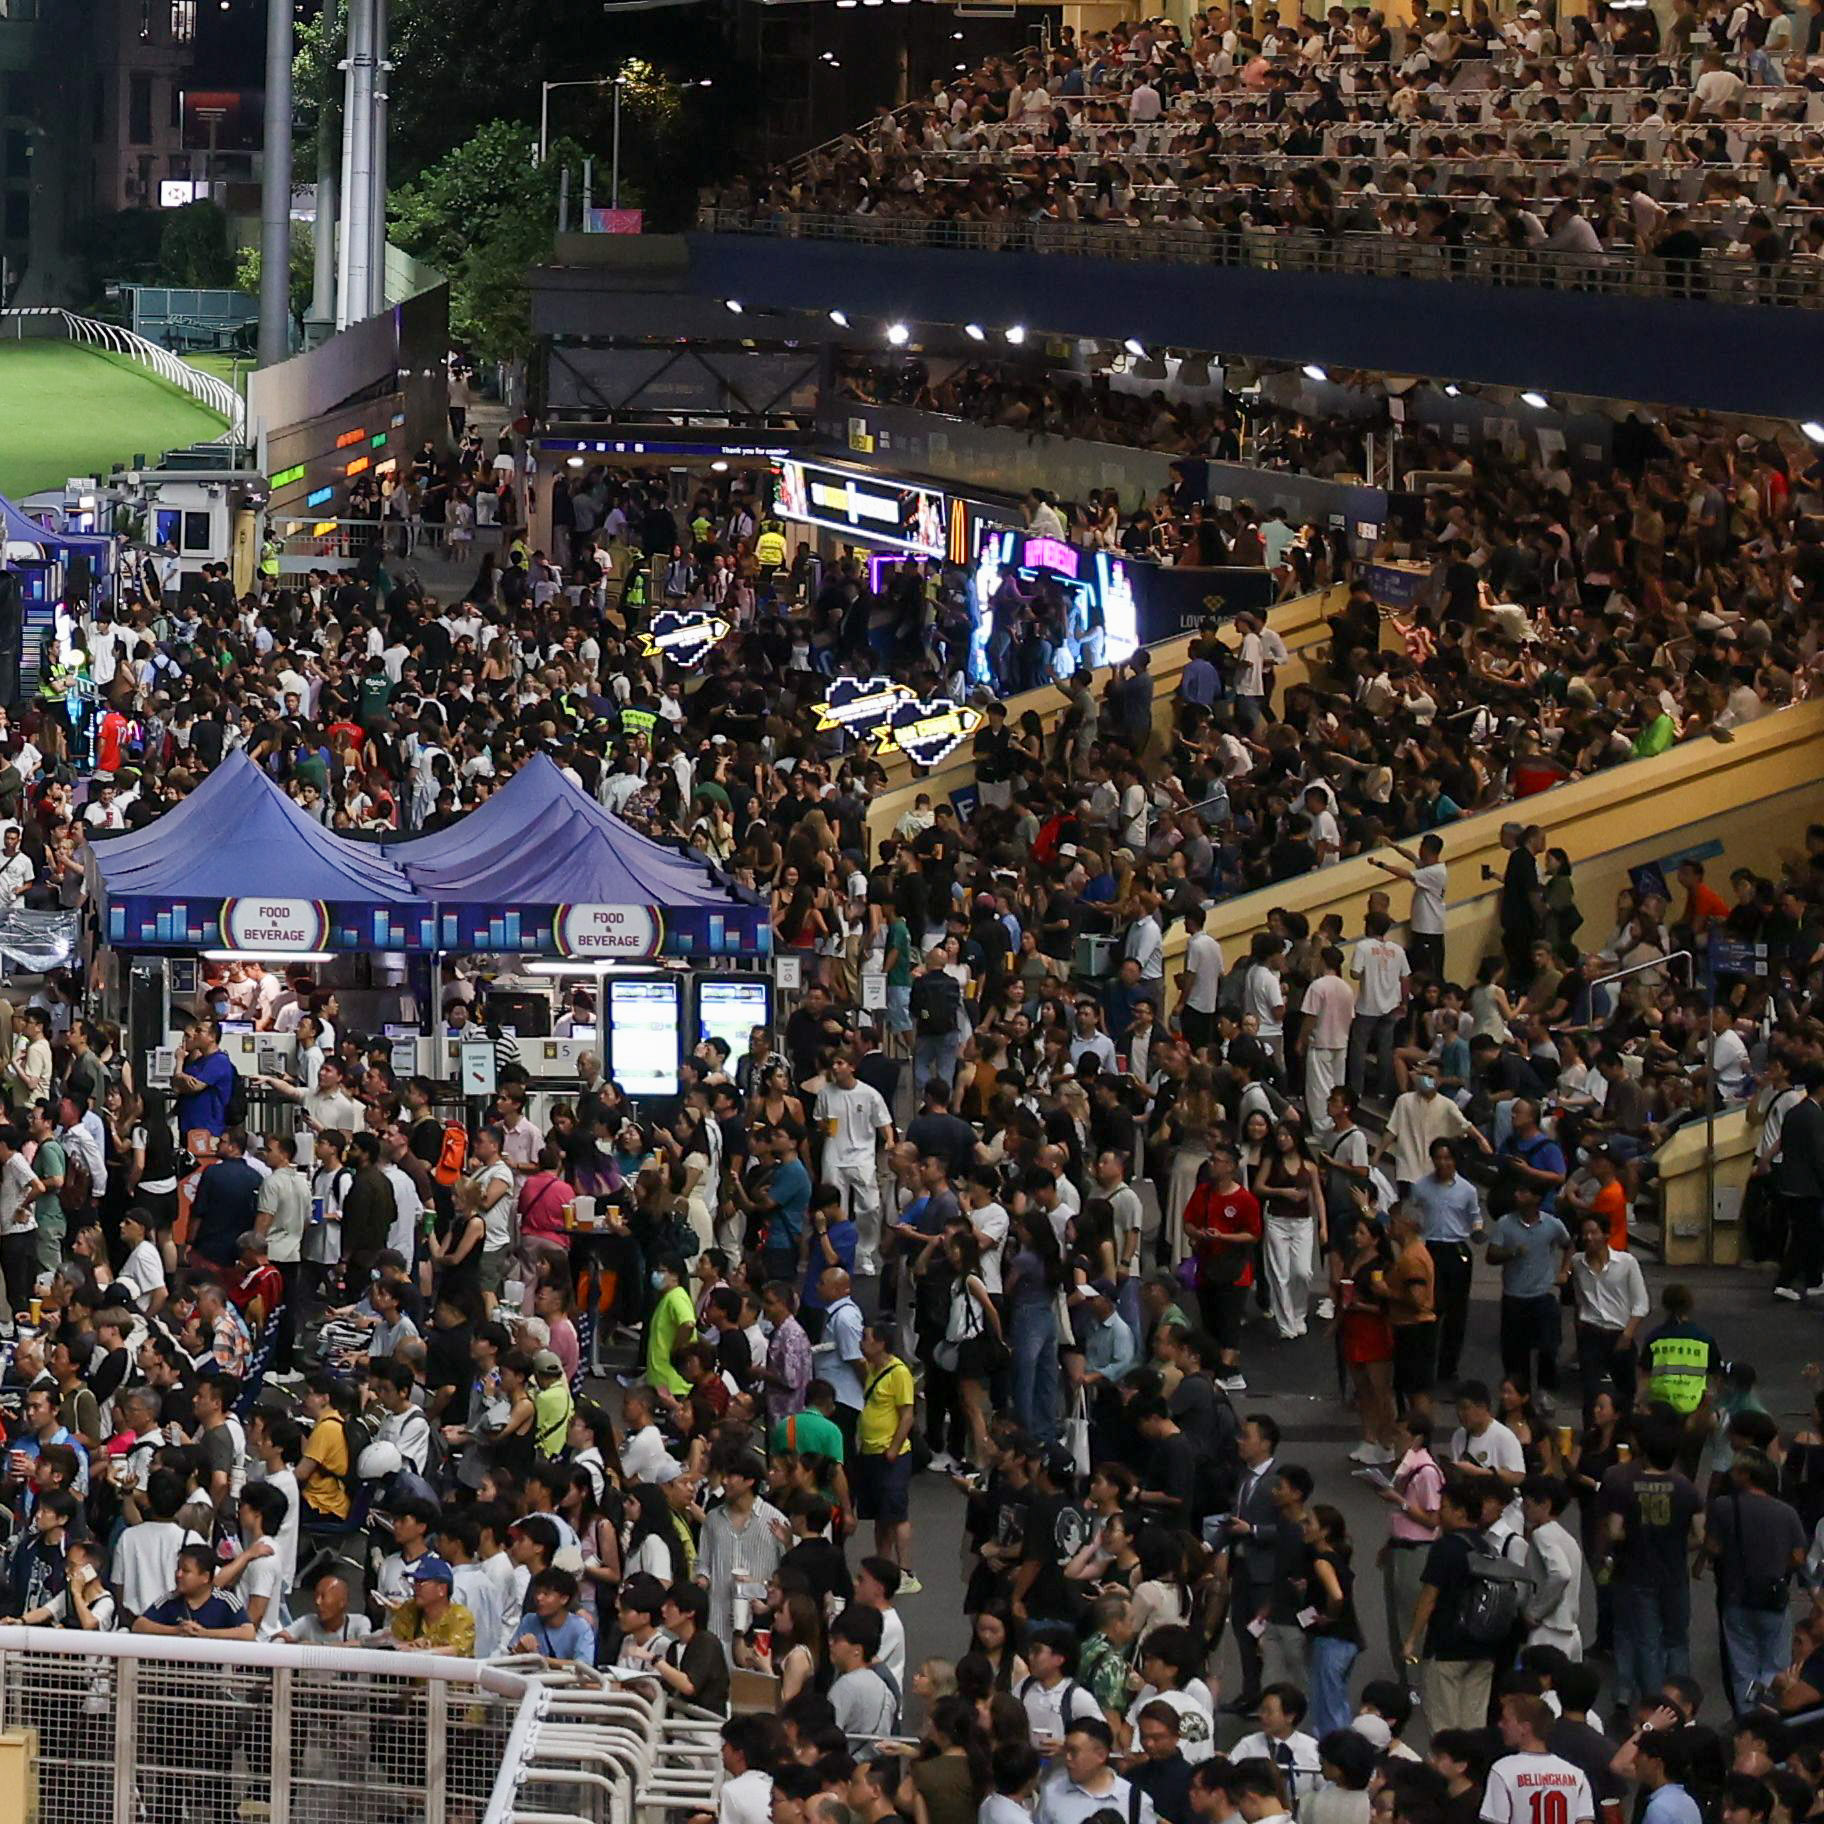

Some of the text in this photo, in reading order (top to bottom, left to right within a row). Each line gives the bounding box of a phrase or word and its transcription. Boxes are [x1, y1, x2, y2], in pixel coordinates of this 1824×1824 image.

[721, 446, 741, 455] Thank
[742, 448, 754, 456] you
[259, 906, 290, 918] FOOD
[593, 912, 624, 924] FOOD
[244, 929, 305, 941] BEVERAGE
[578, 935, 640, 946] BEVERAGE
[562, 1045, 570, 1057] 5
[1517, 1772, 1577, 1788] BELLINGHAM
[1529, 1790, 1568, 1824] 10
